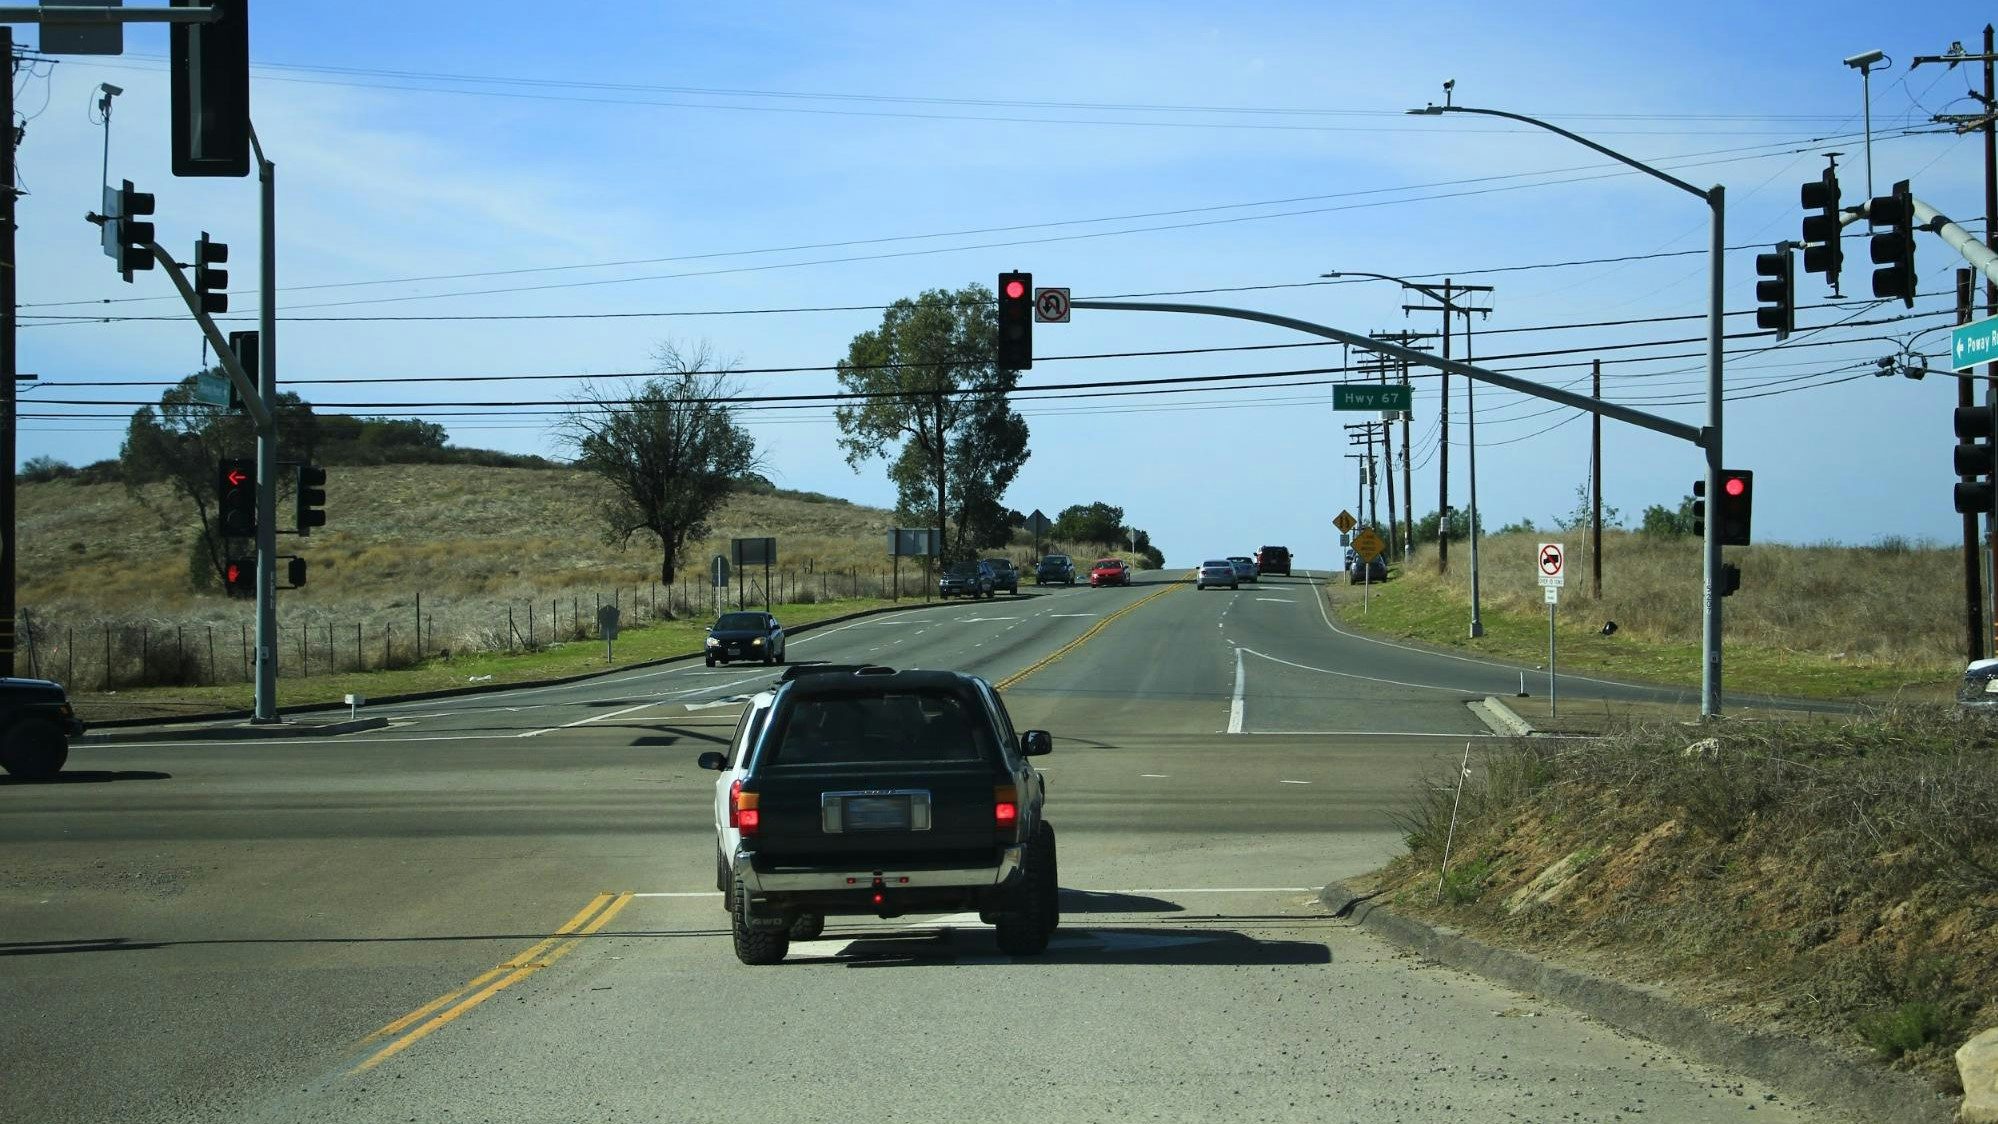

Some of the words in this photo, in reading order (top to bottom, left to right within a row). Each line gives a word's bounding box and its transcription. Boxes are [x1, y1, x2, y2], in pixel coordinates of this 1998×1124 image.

[1967, 337, 1989, 353] Poway
[1345, 393, 1374, 405] Hwy
[1382, 393, 1399, 403] 67
